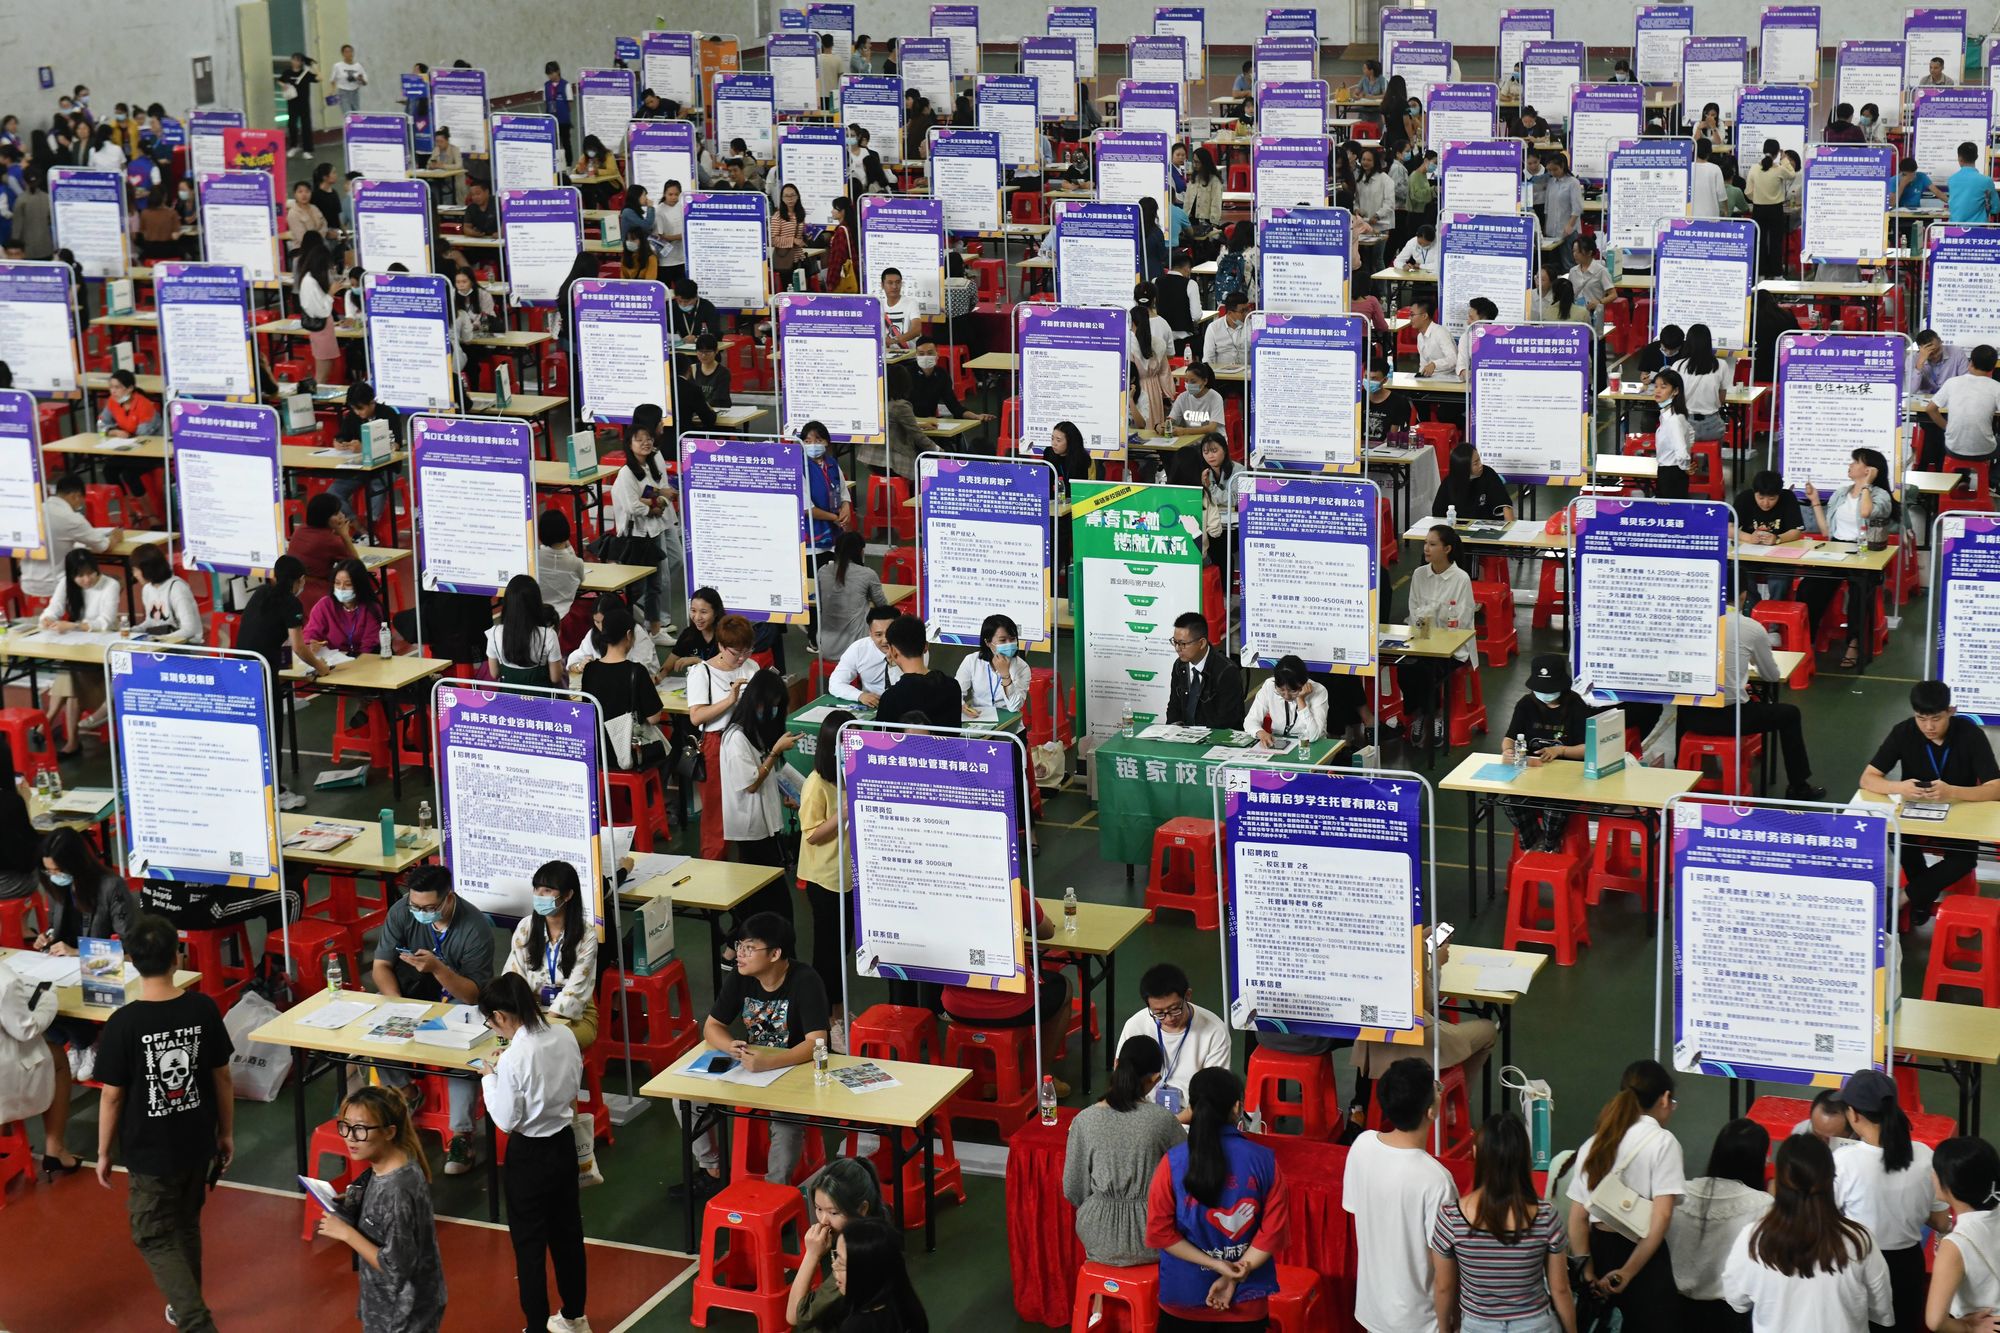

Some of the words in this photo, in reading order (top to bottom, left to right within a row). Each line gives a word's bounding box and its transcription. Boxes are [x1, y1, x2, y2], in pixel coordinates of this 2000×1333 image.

[1184, 410, 1210, 422] CHINA
[710, 454, 774, 465] 保利物业三亚分公司
[958, 475, 1013, 486] 贝壳找房房地产
[1620, 517, 1684, 528] 易贝乐少儿英语
[160, 672, 215, 686] 深圳免税集团
[460, 711, 572, 734] 海南天略企业咨询有限公司
[458, 751, 483, 760] 招聘岗位
[1247, 791, 1398, 812] 海南新启梦学生托管有限公司
[866, 805, 893, 814] 招聘岗位
[1248, 848, 1279, 858] 招聘岗位
[464, 879, 490, 889] 联系信息
[1697, 874, 1730, 884] 招聘岗位
[1797, 894, 1863, 906] 3000-5000元/月
[872, 930, 900, 940] 联系信息
[1703, 925, 1747, 935] 二、会计助理
[1251, 979, 1282, 988] 联系信息
[1792, 976, 1858, 988] 3000-5000元/月
[1696, 1020, 1730, 1030] 联系信息
[141, 1031, 170, 1044] OFF
[174, 1026, 202, 1037] THE
[154, 1038, 191, 1050] WALL
[148, 1108, 174, 1117] LAST
